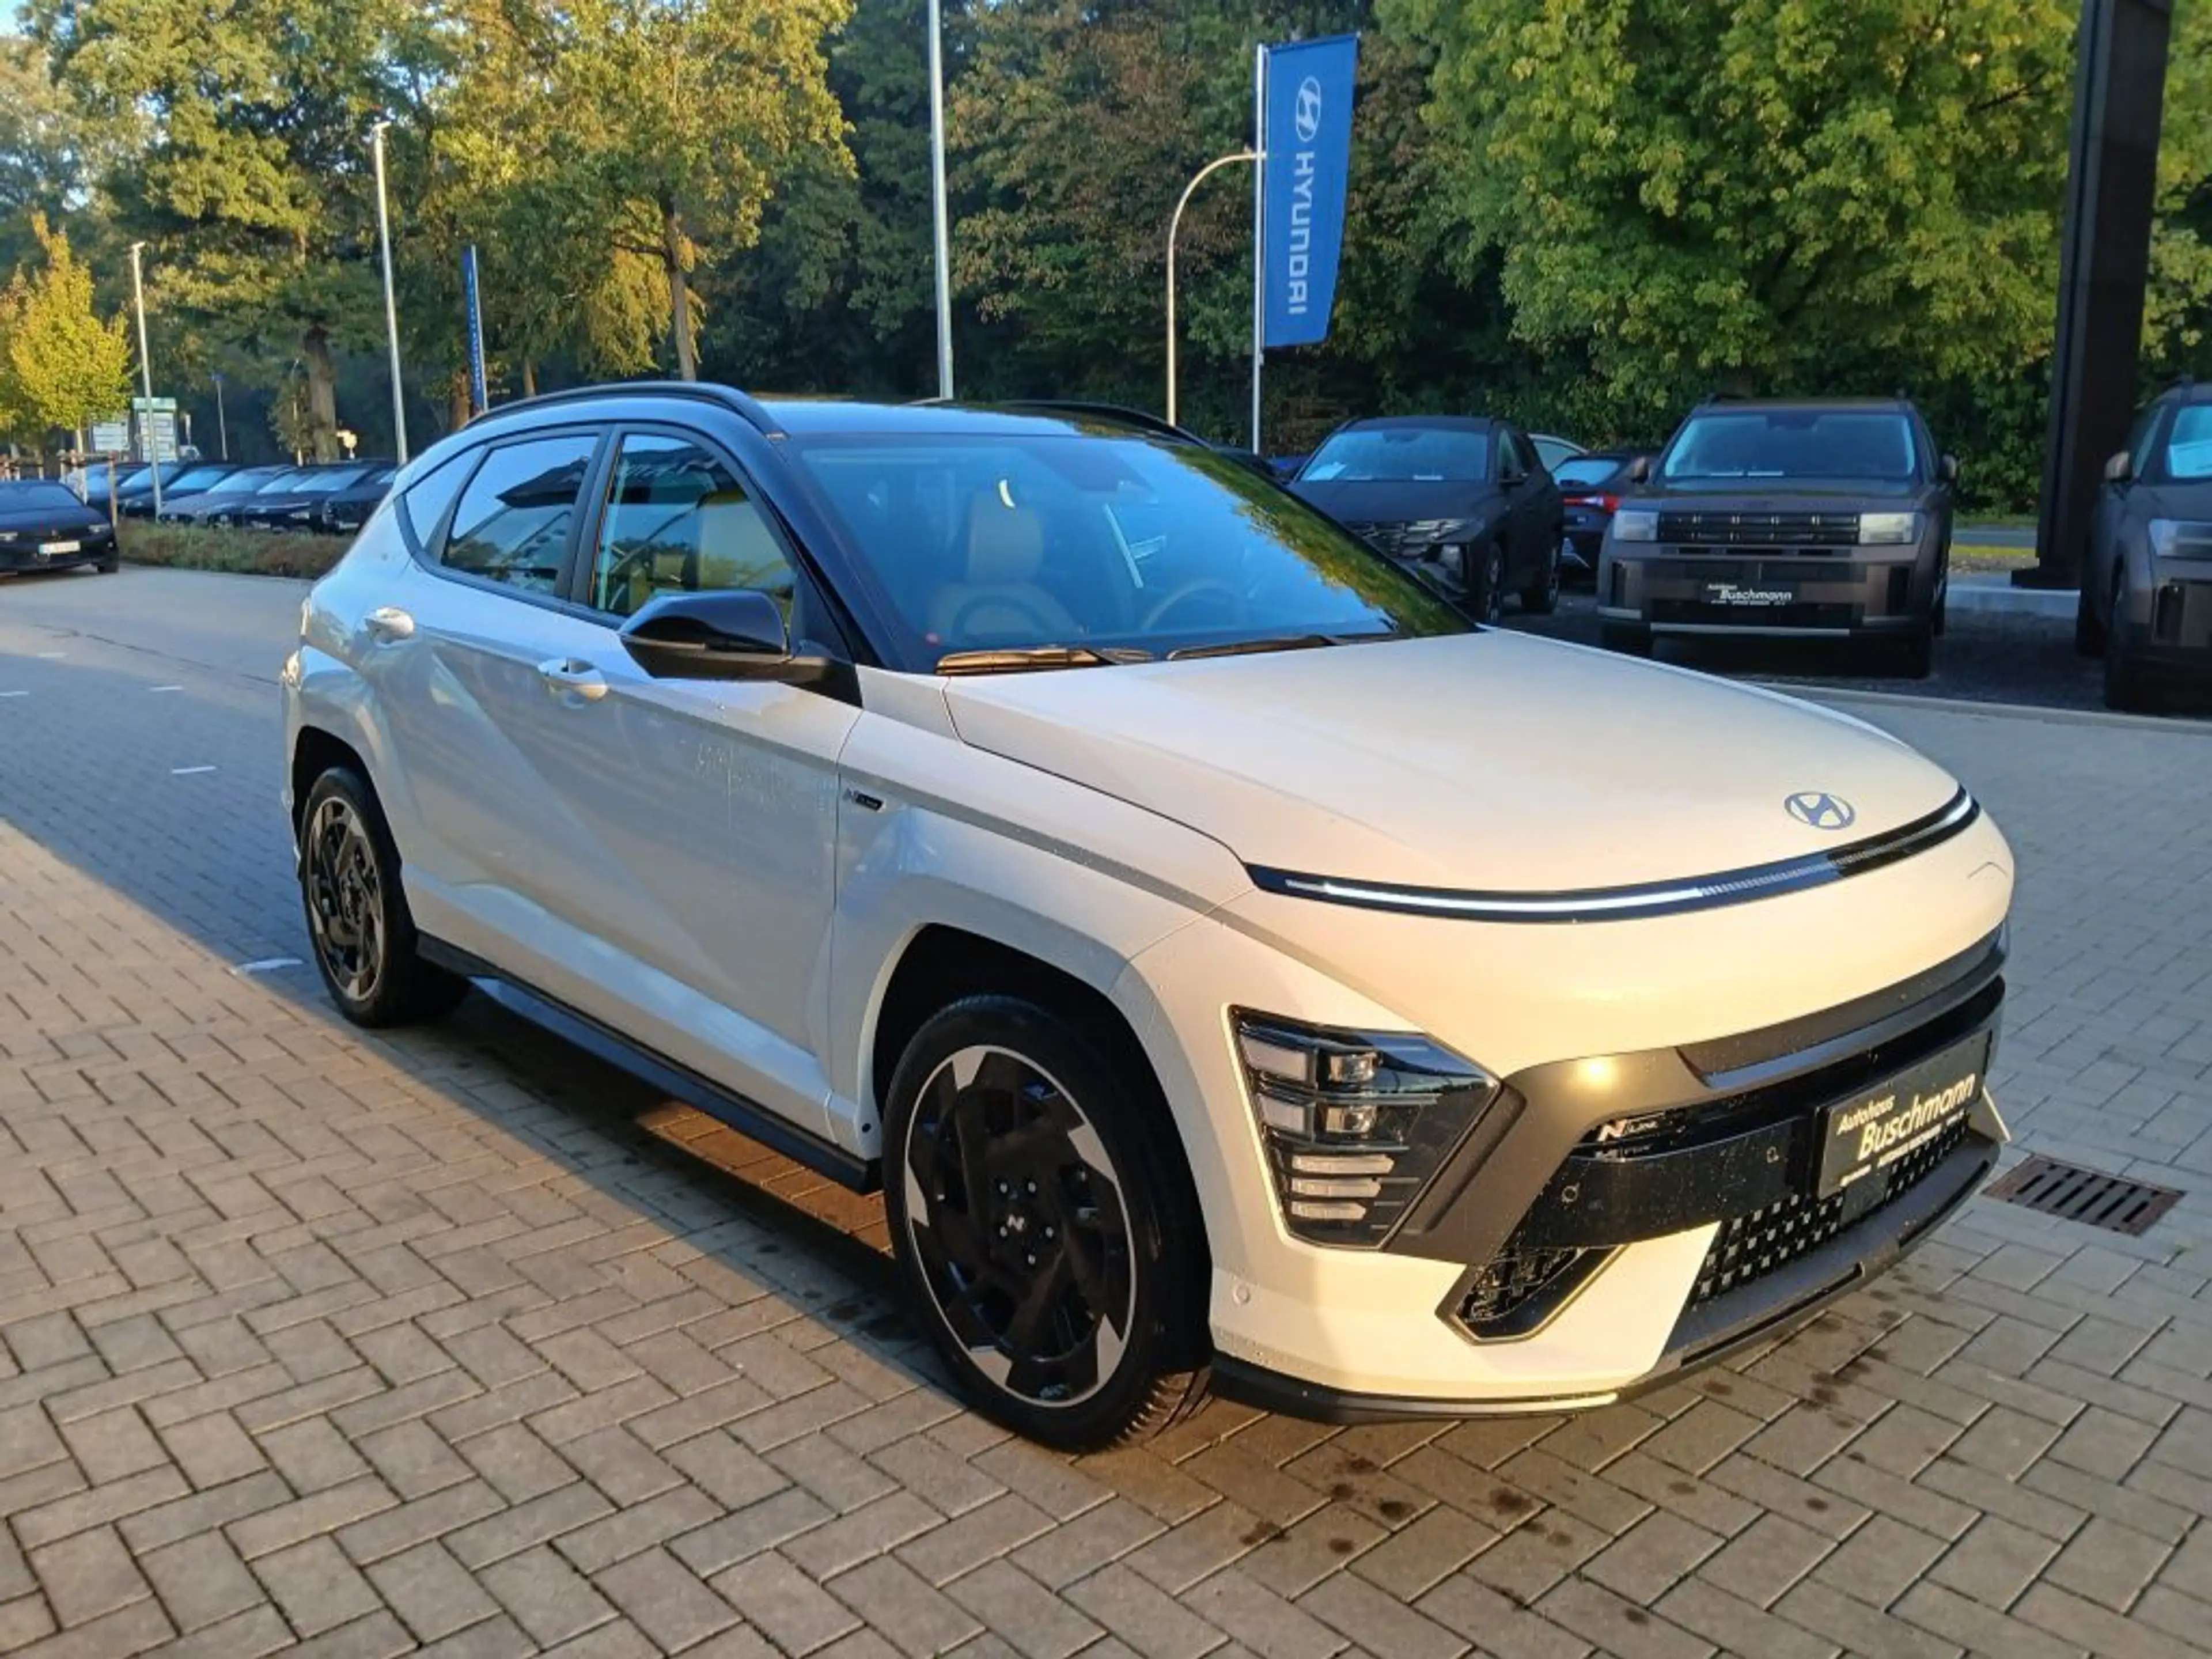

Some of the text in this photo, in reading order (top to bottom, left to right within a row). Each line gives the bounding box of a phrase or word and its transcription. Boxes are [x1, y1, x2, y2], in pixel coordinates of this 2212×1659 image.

[1288, 151, 1315, 315] HYUNDAI
[1720, 588, 1792, 600] Buschmann
[1836, 1095, 1896, 1136] Autohaus
[1858, 1073, 1976, 1161] Buschmann
